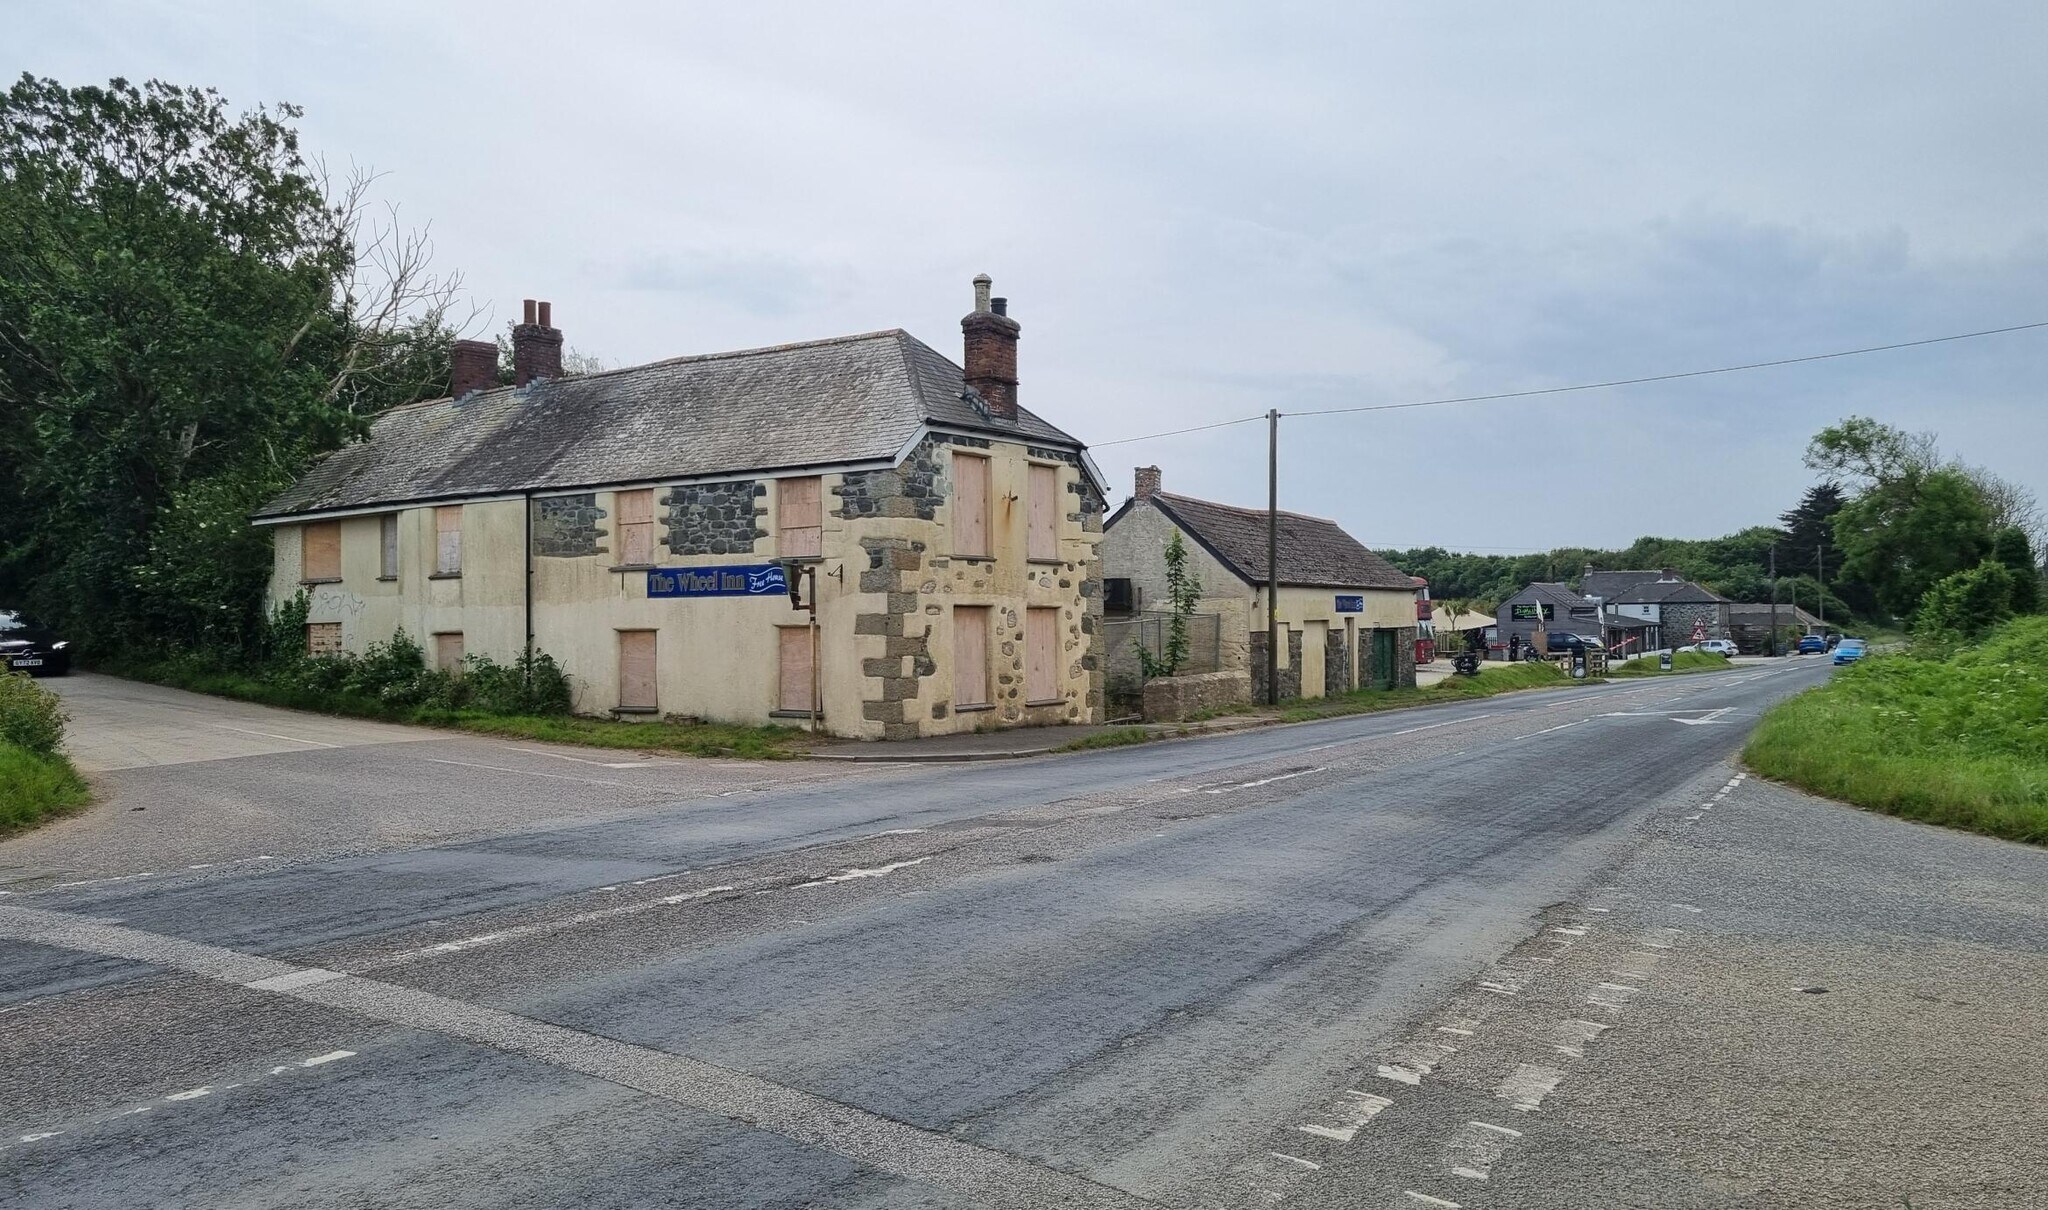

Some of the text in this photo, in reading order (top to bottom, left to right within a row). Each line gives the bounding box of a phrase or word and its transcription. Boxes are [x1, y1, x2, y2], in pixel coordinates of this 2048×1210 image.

[649, 570, 745, 593] The Wheel Inn
[749, 571, 784, 589] Free House
